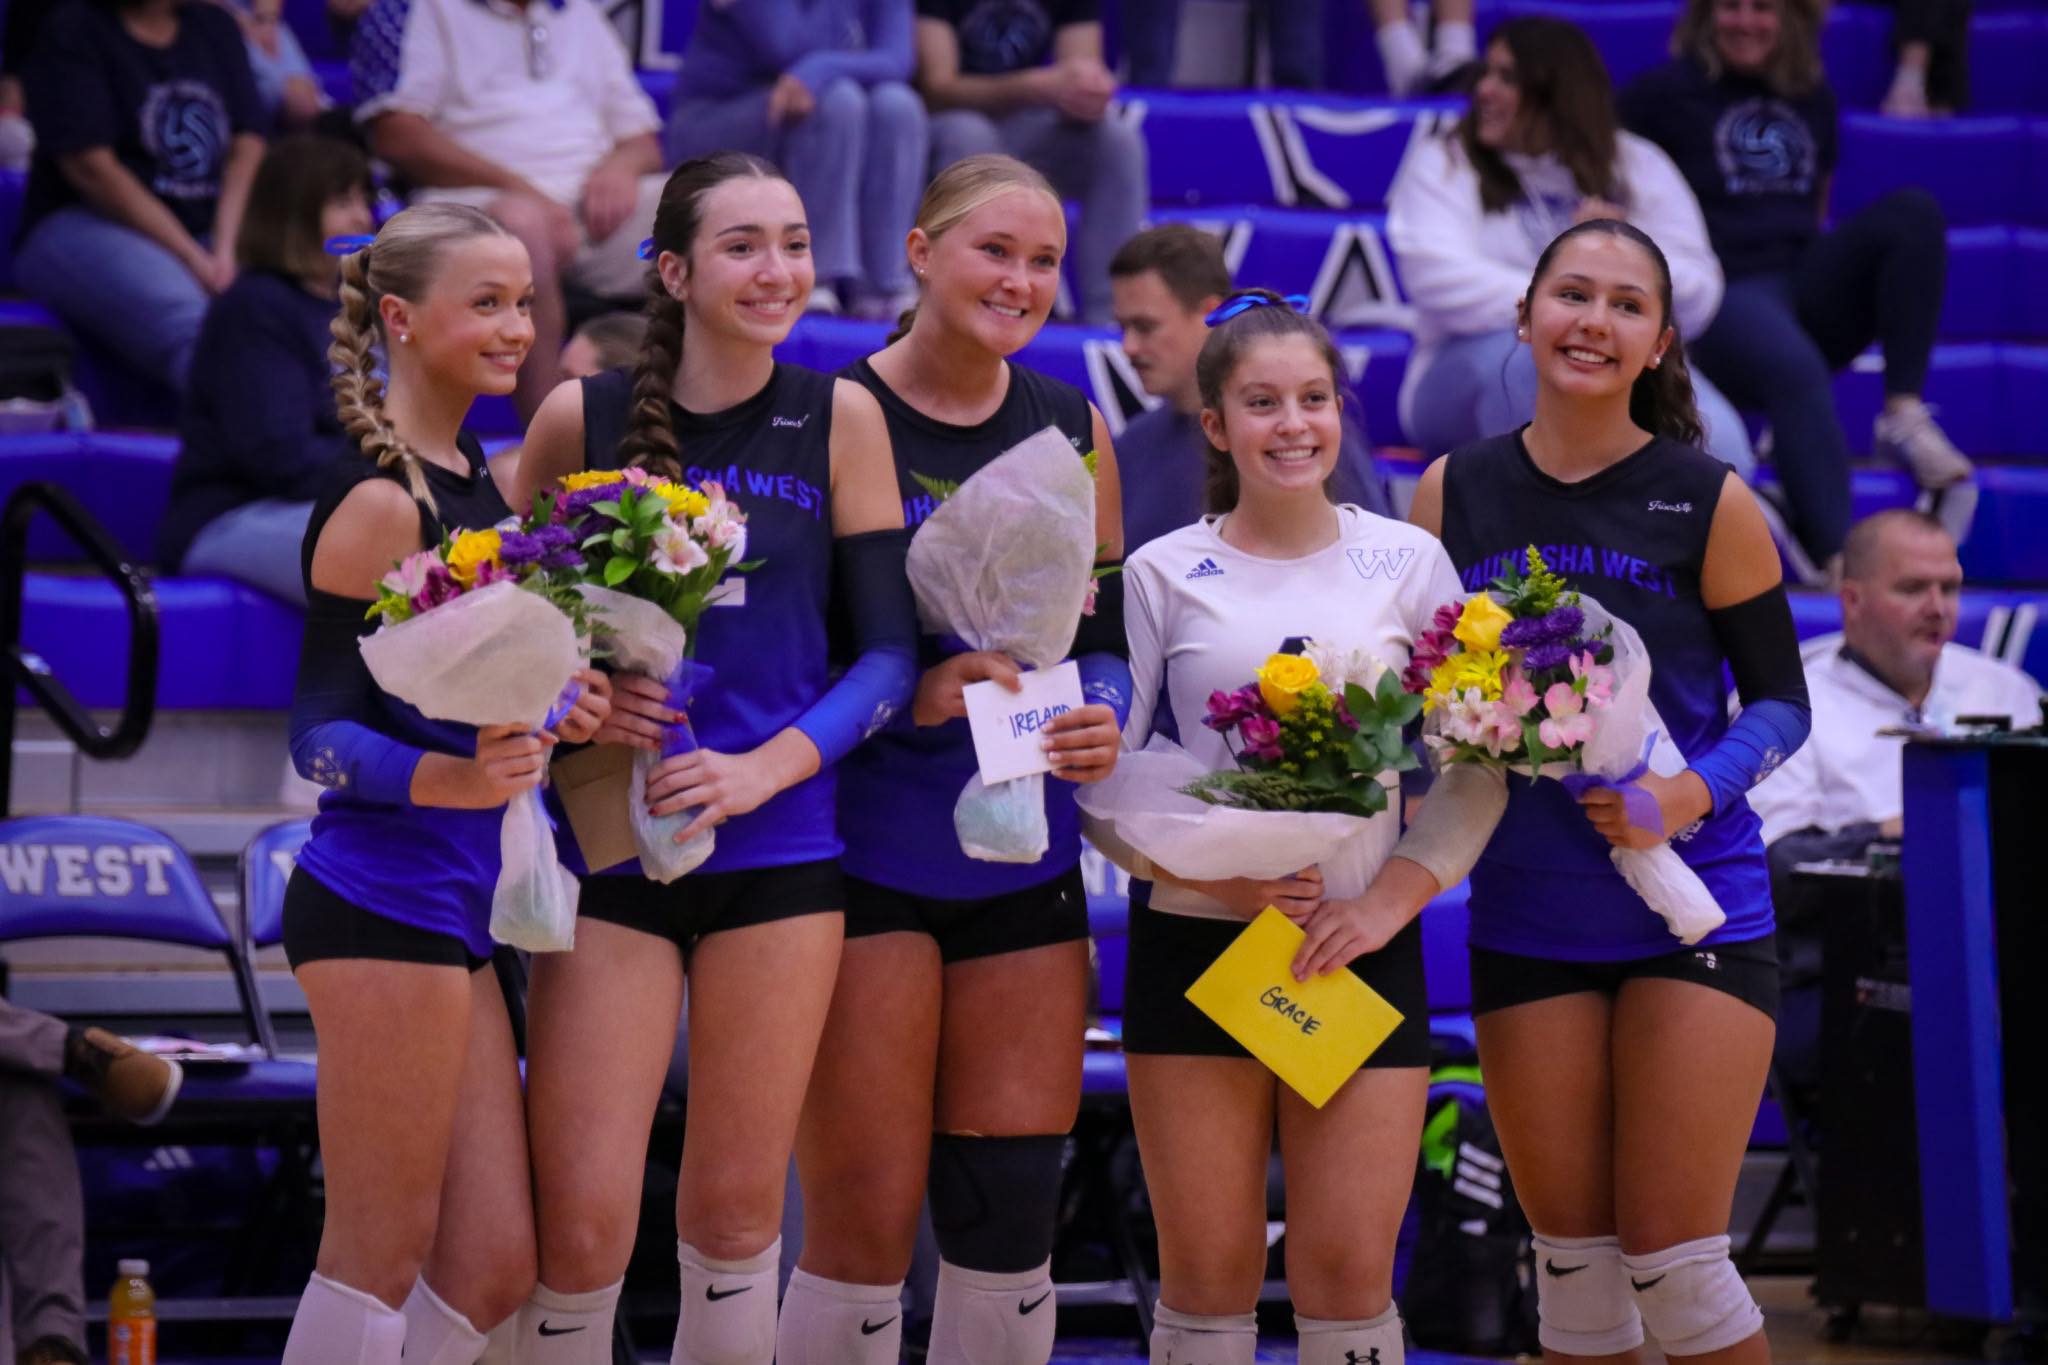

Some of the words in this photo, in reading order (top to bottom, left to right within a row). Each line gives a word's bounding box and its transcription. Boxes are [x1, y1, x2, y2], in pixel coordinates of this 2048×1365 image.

[744, 467, 824, 520] WEST
[1185, 567, 1224, 580] adidas
[1346, 548, 1415, 580] W
[0, 843, 175, 897] WEST
[1260, 985, 1323, 1037] GRACE
